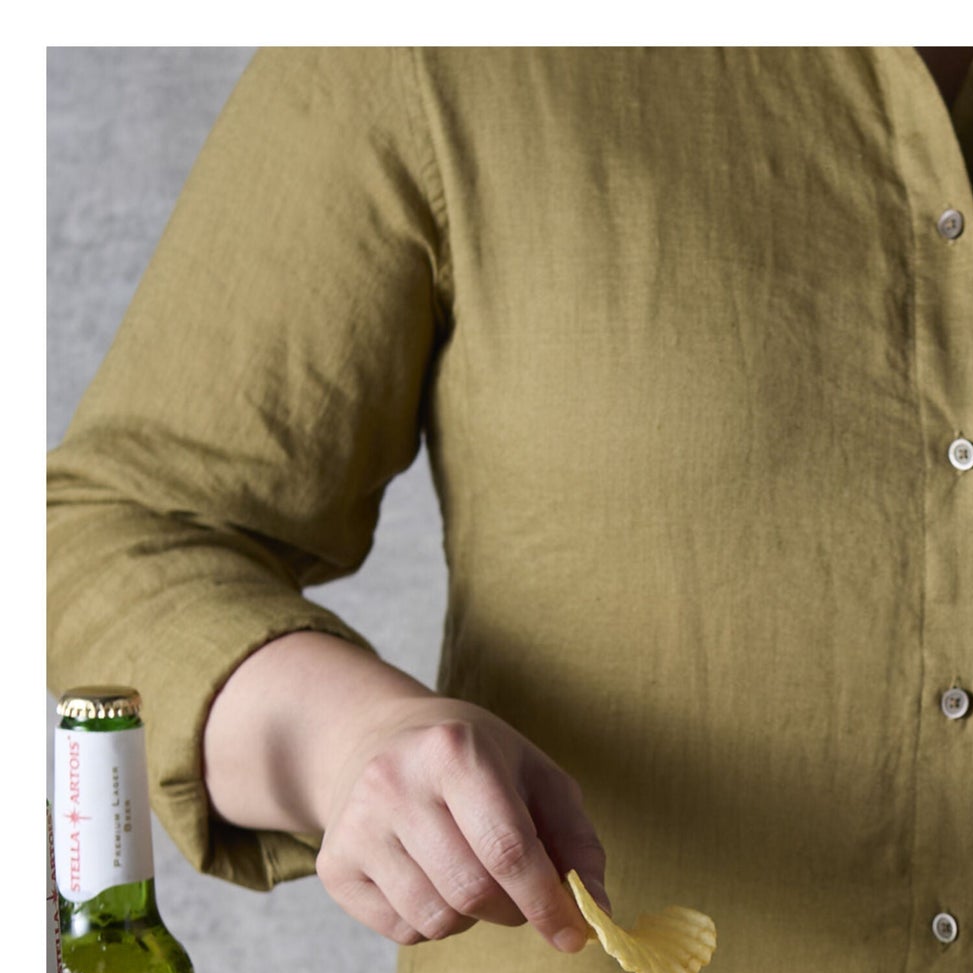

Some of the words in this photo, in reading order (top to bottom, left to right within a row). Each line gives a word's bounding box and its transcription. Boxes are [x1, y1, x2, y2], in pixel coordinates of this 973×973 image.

[69, 741, 80, 805] ARTOIS
[112, 766, 120, 807] LAGER
[70, 831, 81, 893] STELLA
[113, 813, 122, 868] PREMIUM
